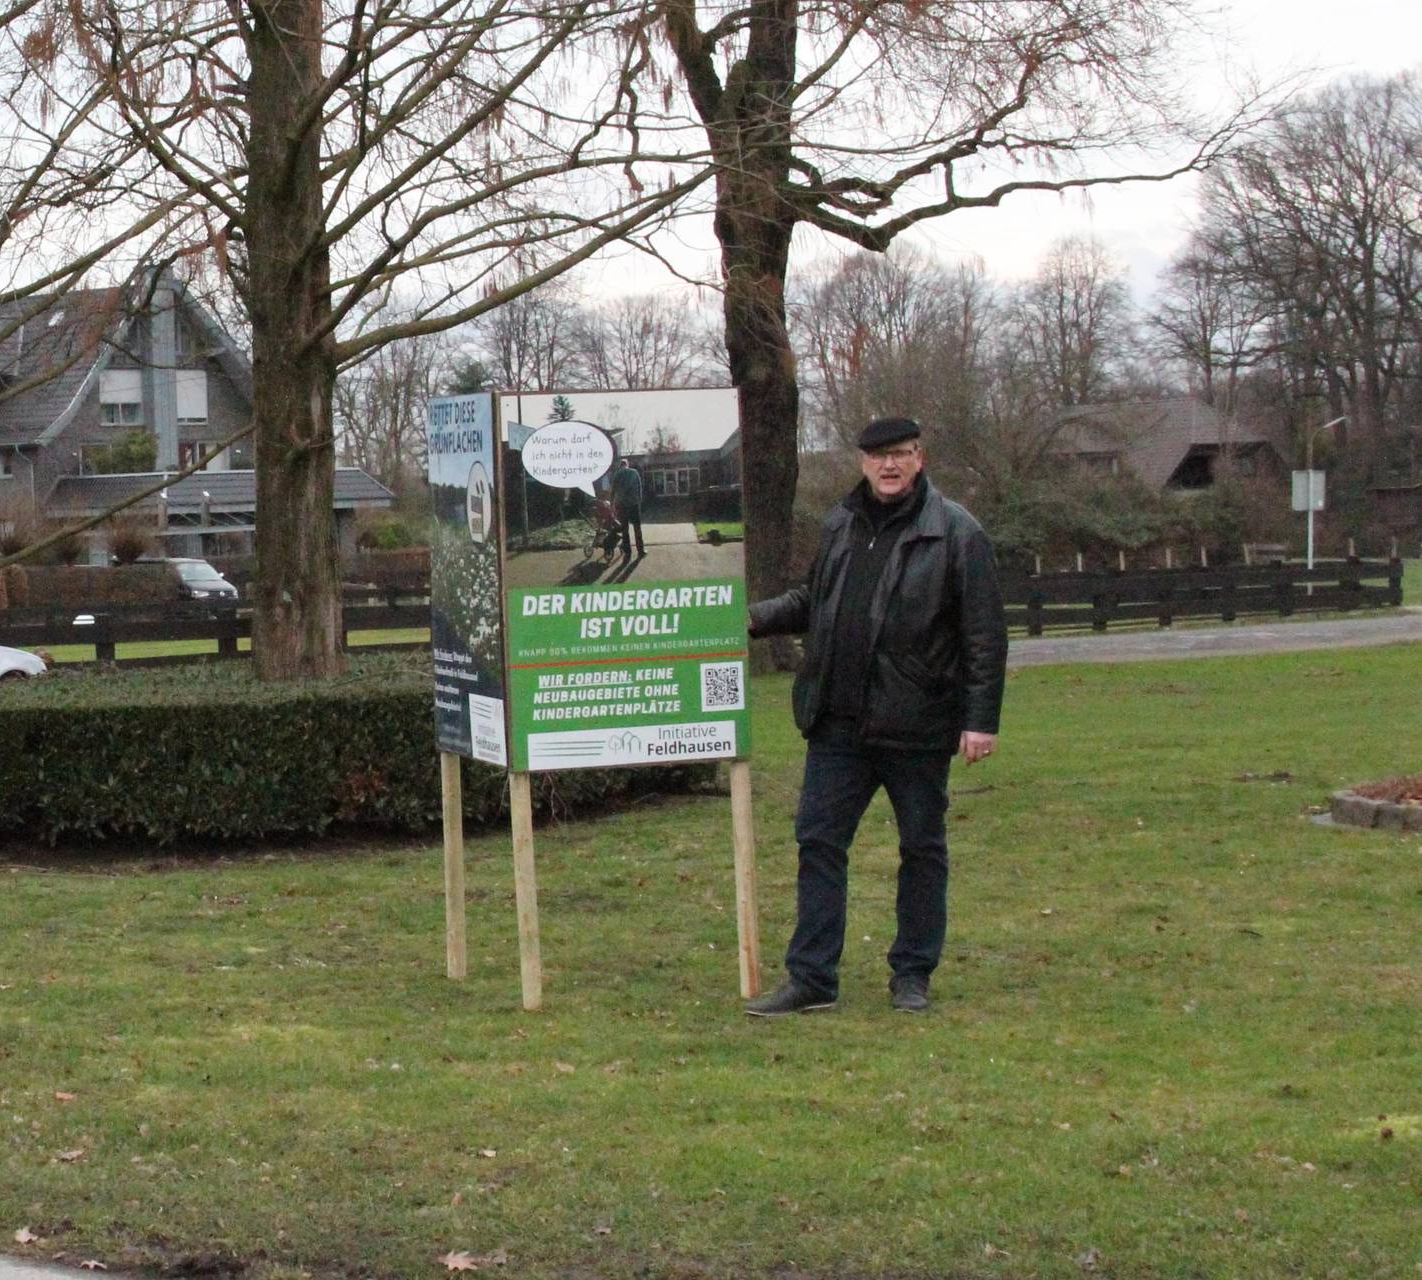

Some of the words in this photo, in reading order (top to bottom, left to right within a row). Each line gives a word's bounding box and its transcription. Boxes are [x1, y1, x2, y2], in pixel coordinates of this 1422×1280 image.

[429, 403, 453, 426] RETTET
[455, 401, 475, 424] DIESE
[429, 425, 483, 455] GRÜNFLÄCHEN
[531, 435, 567, 445] Warum
[570, 431, 592, 444] darf
[532, 450, 546, 460] ich
[549, 447, 573, 460] nicht
[576, 450, 585, 459] in
[587, 447, 604, 459] den
[522, 594, 565, 616] DER
[570, 585, 732, 613] KINDERGARTEN
[580, 617, 616, 639] IST
[620, 613, 680, 637] VOLL!
[518, 648, 547, 657] KNAPP
[571, 644, 618, 655] BEKOMMEN
[620, 642, 650, 652] KEINEN
[653, 636, 740, 650] KINDERGARTENPLATZ
[539, 674, 564, 688] WIR
[568, 670, 633, 687] FORDERN:
[636, 668, 674, 682] KEINE
[534, 686, 641, 704] NEUBAUGEBIETE
[645, 684, 679, 697] OHNE
[533, 700, 680, 721] KINDERGARTENPLÄTZE
[658, 725, 717, 739] Initiative
[647, 740, 731, 756] Feldhausen
